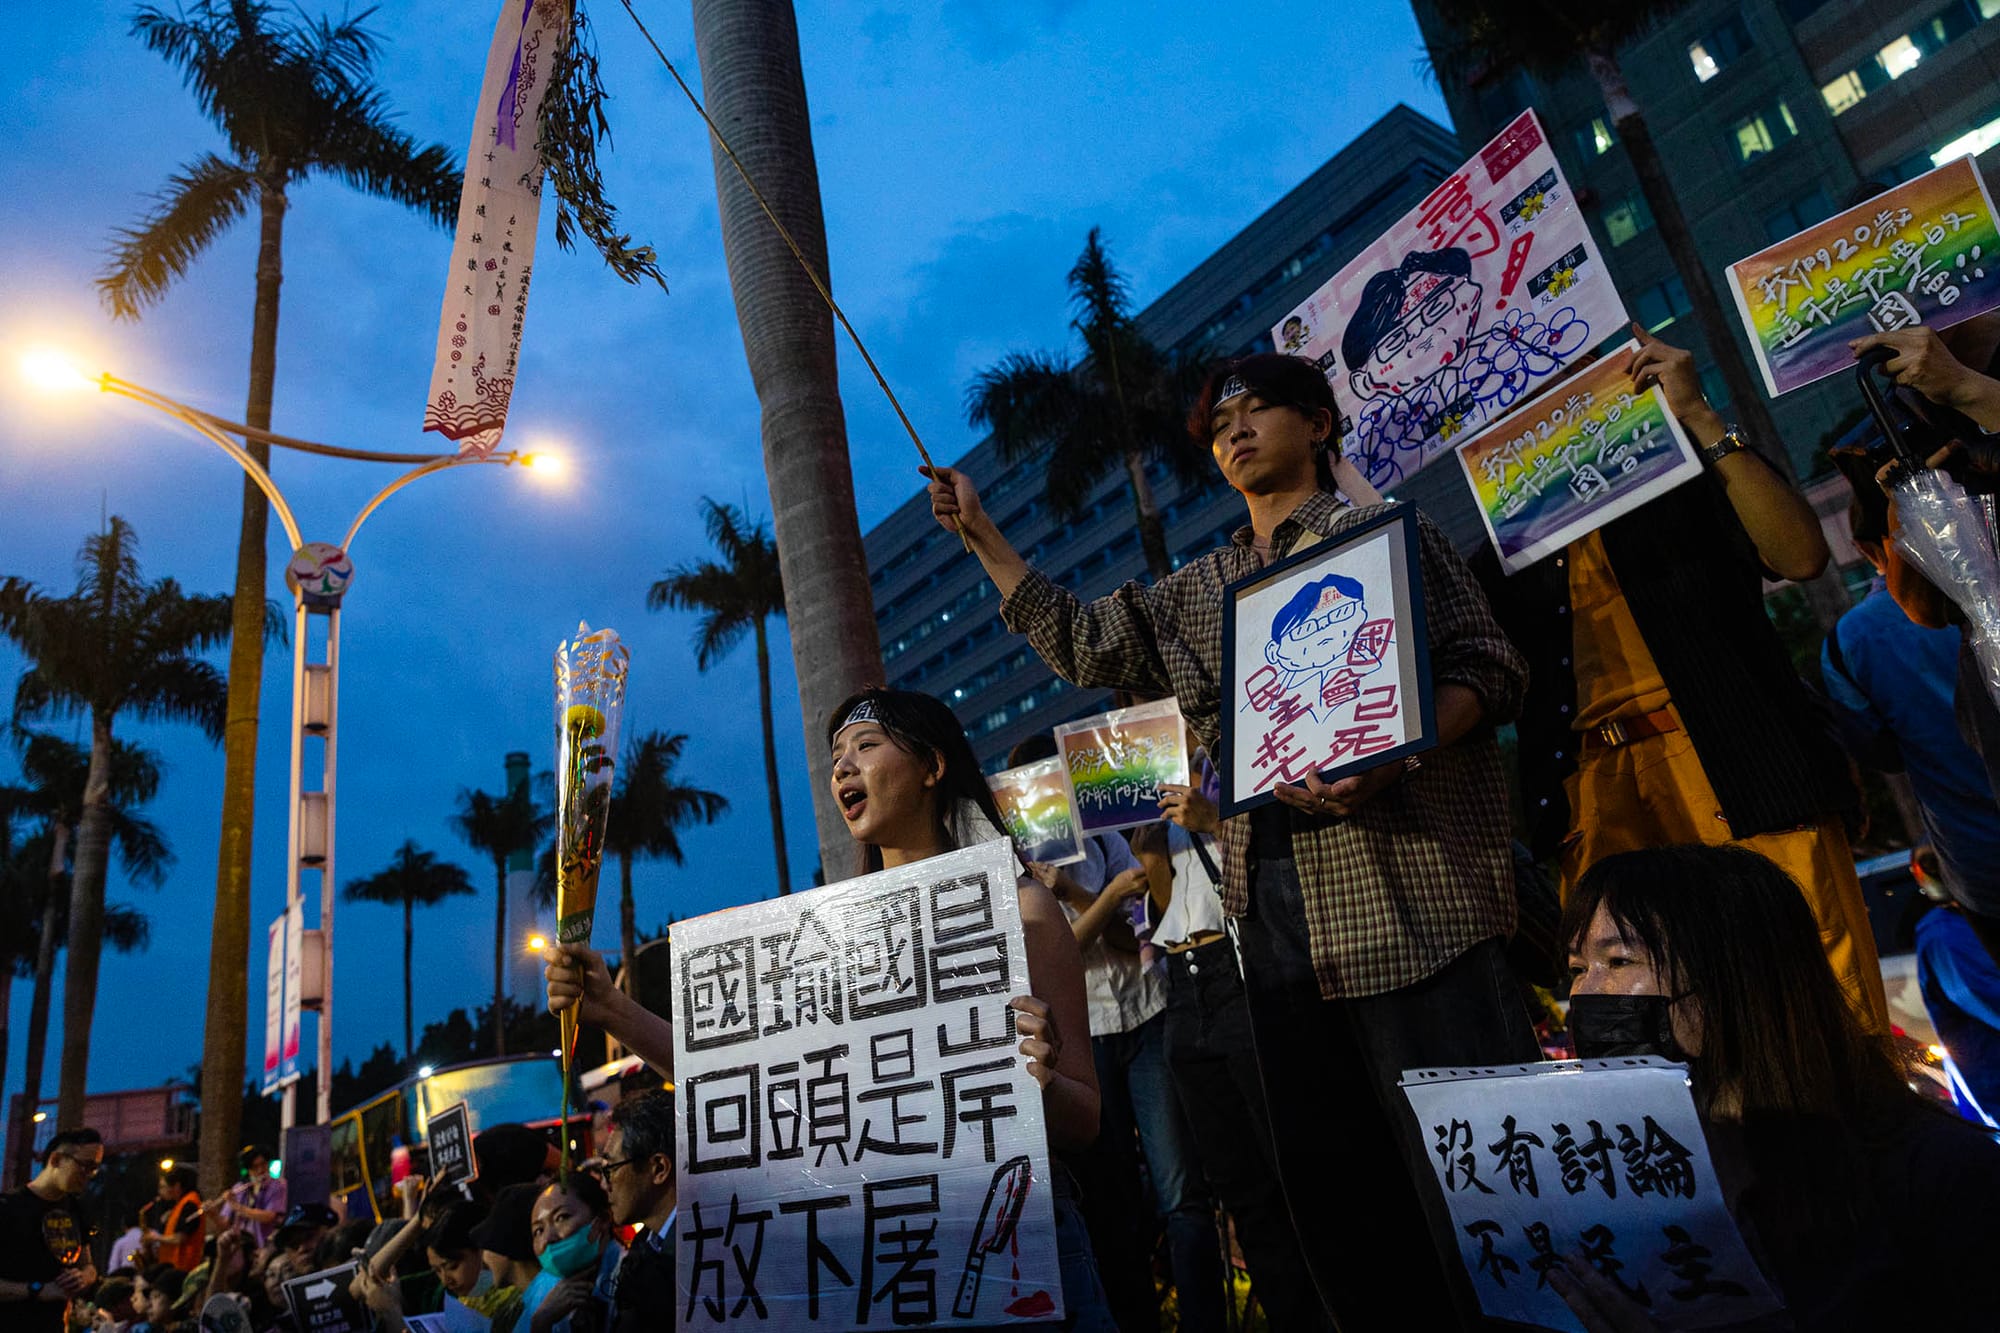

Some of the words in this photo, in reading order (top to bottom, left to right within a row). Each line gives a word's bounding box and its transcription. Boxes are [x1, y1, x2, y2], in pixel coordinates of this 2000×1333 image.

[680, 870, 1014, 1053] 國瑜國昌
[685, 1004, 1018, 1175] 回頭是岸
[1432, 1114, 1697, 1202] 沒有討論
[1462, 1219, 1752, 1308] 不是民主
